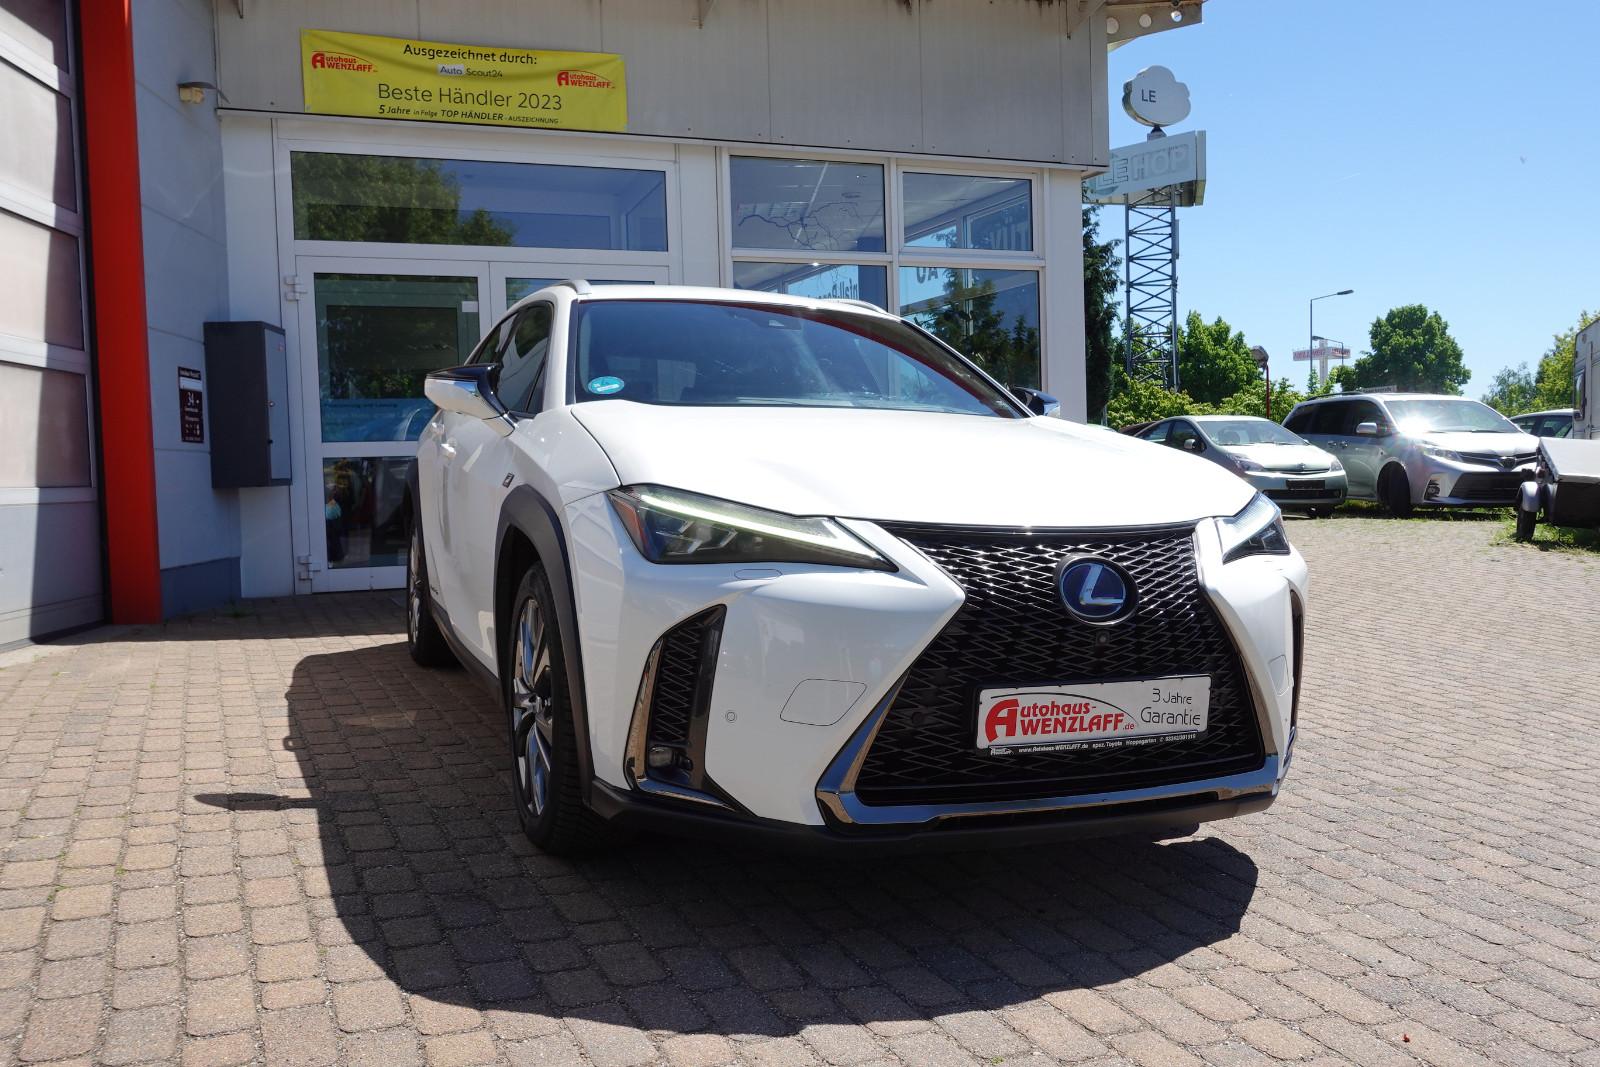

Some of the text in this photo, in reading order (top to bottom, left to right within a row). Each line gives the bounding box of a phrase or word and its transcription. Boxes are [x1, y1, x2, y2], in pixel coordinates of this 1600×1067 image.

[403, 44, 538, 65] Ausgezeichnet durch:
[378, 83, 562, 111] Beste Händler 2023
[1141, 88, 1157, 103] LE
[378, 104, 385, 115] 5
[386, 105, 411, 116] Jahre
[441, 109, 460, 118] TOP
[1152, 688, 1192, 705] 3 Jahre
[1140, 706, 1201, 726] Garantie
